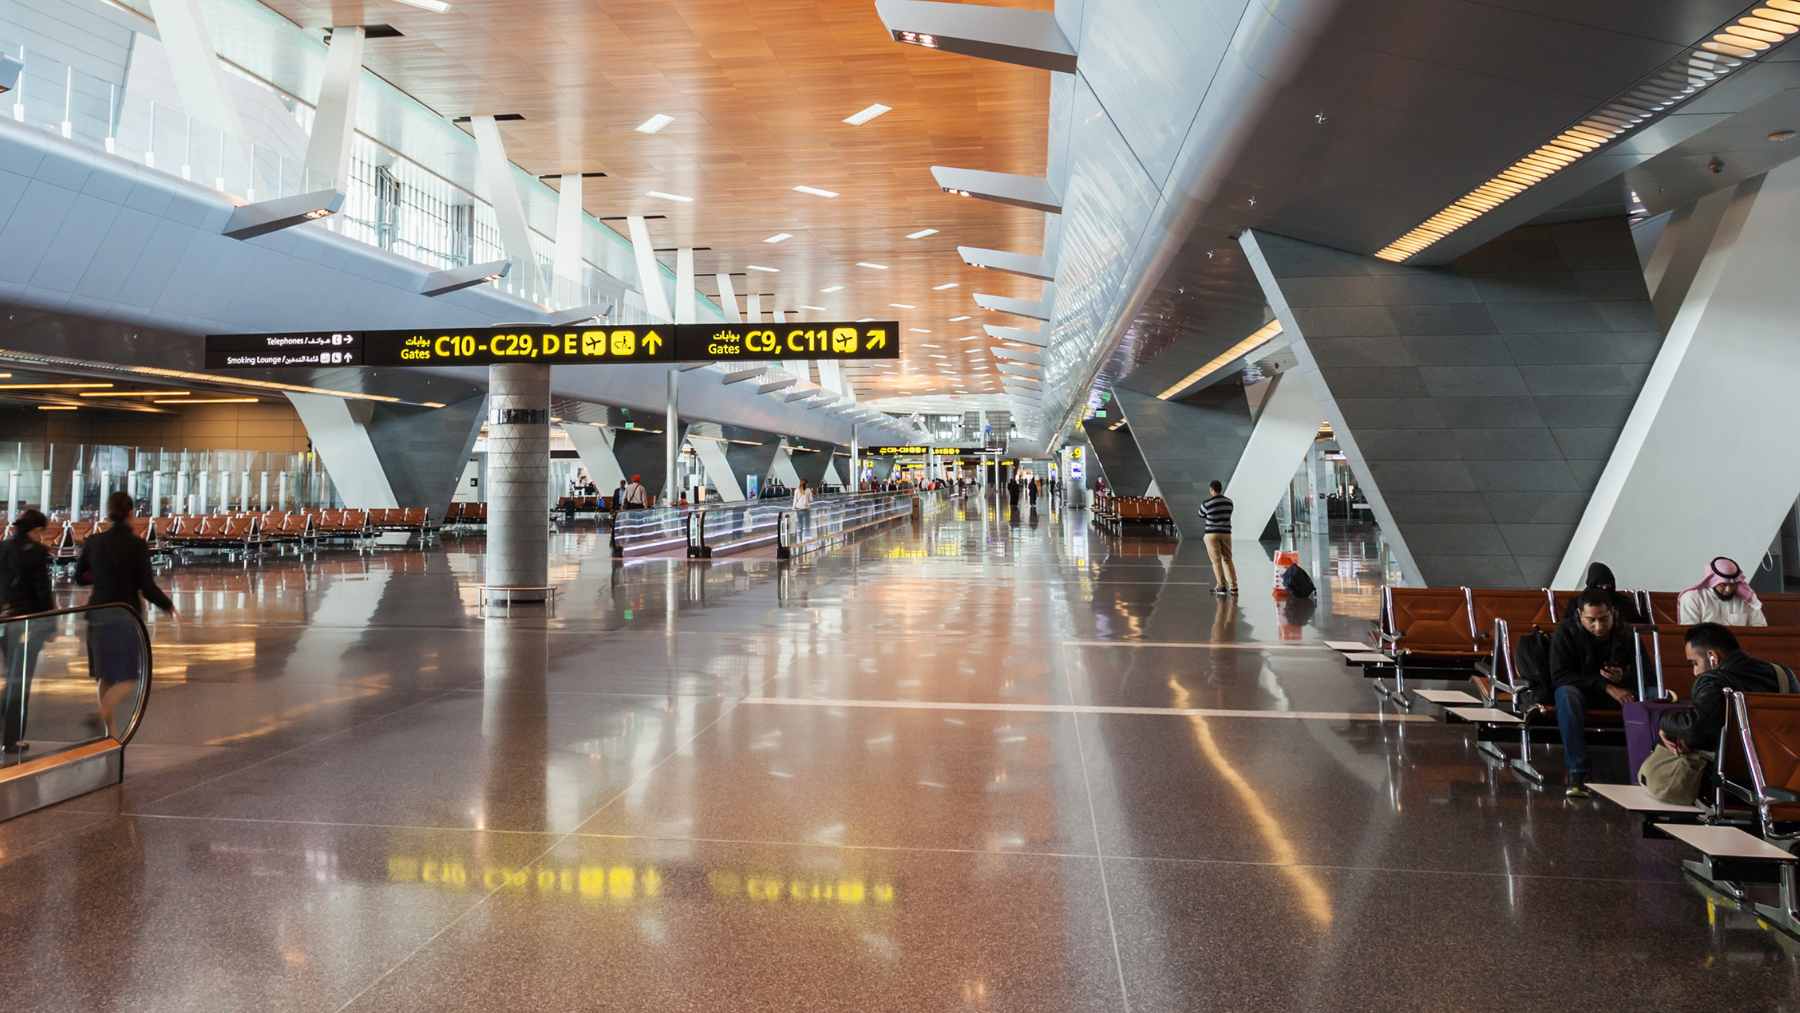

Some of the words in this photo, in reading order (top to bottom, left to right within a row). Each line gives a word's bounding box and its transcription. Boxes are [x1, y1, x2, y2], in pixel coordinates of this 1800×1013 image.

[266, 337, 303, 346] Telephones
[405, 336, 430, 347] بوابات
[712, 330, 740, 342] بوابات
[401, 348, 430, 360] Gates
[543, 334, 560, 355] D
[564, 334, 577, 355] E
[708, 343, 740, 355] Gates
[745, 330, 782, 354] C9,
[787, 329, 827, 352] C11
[227, 356, 256, 366] Smoking
